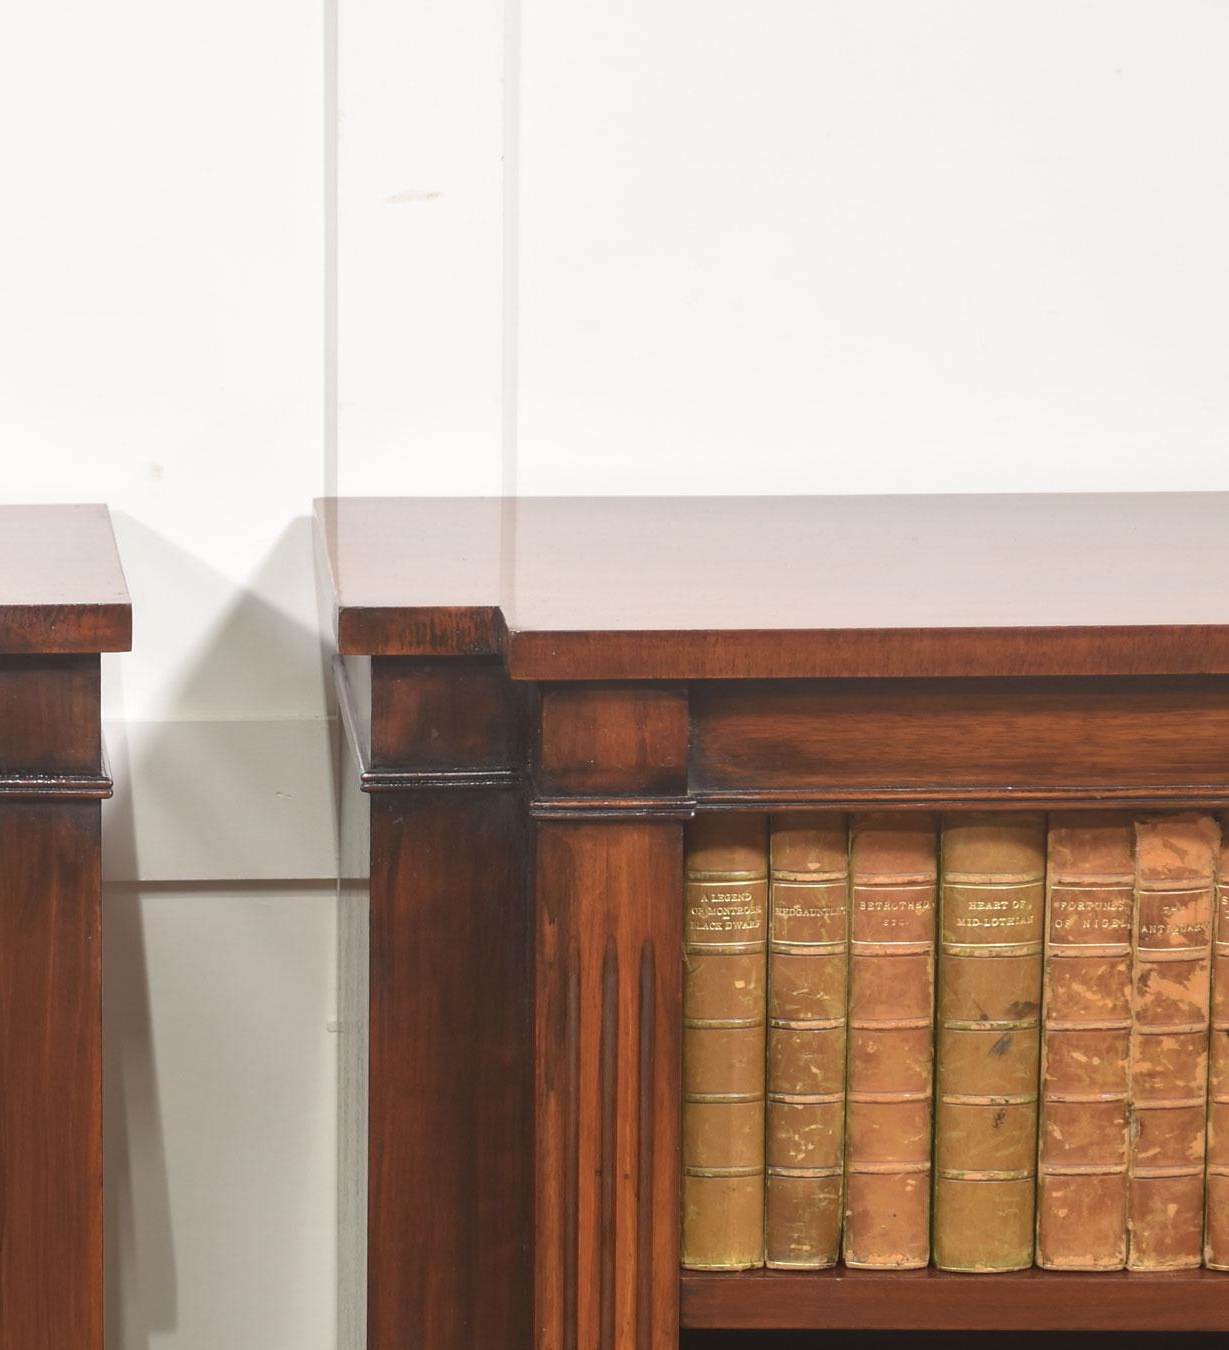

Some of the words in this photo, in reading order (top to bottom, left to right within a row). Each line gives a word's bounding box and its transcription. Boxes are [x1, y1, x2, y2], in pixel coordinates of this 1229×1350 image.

[700, 893, 708, 903] A
[711, 892, 753, 903] LEGEND
[968, 901, 1010, 911] HEART
[1060, 901, 1125, 911] FORTUNES
[690, 920, 722, 931] BLACK
[724, 920, 760, 930] DWARF
[1055, 919, 1072, 929] OF
